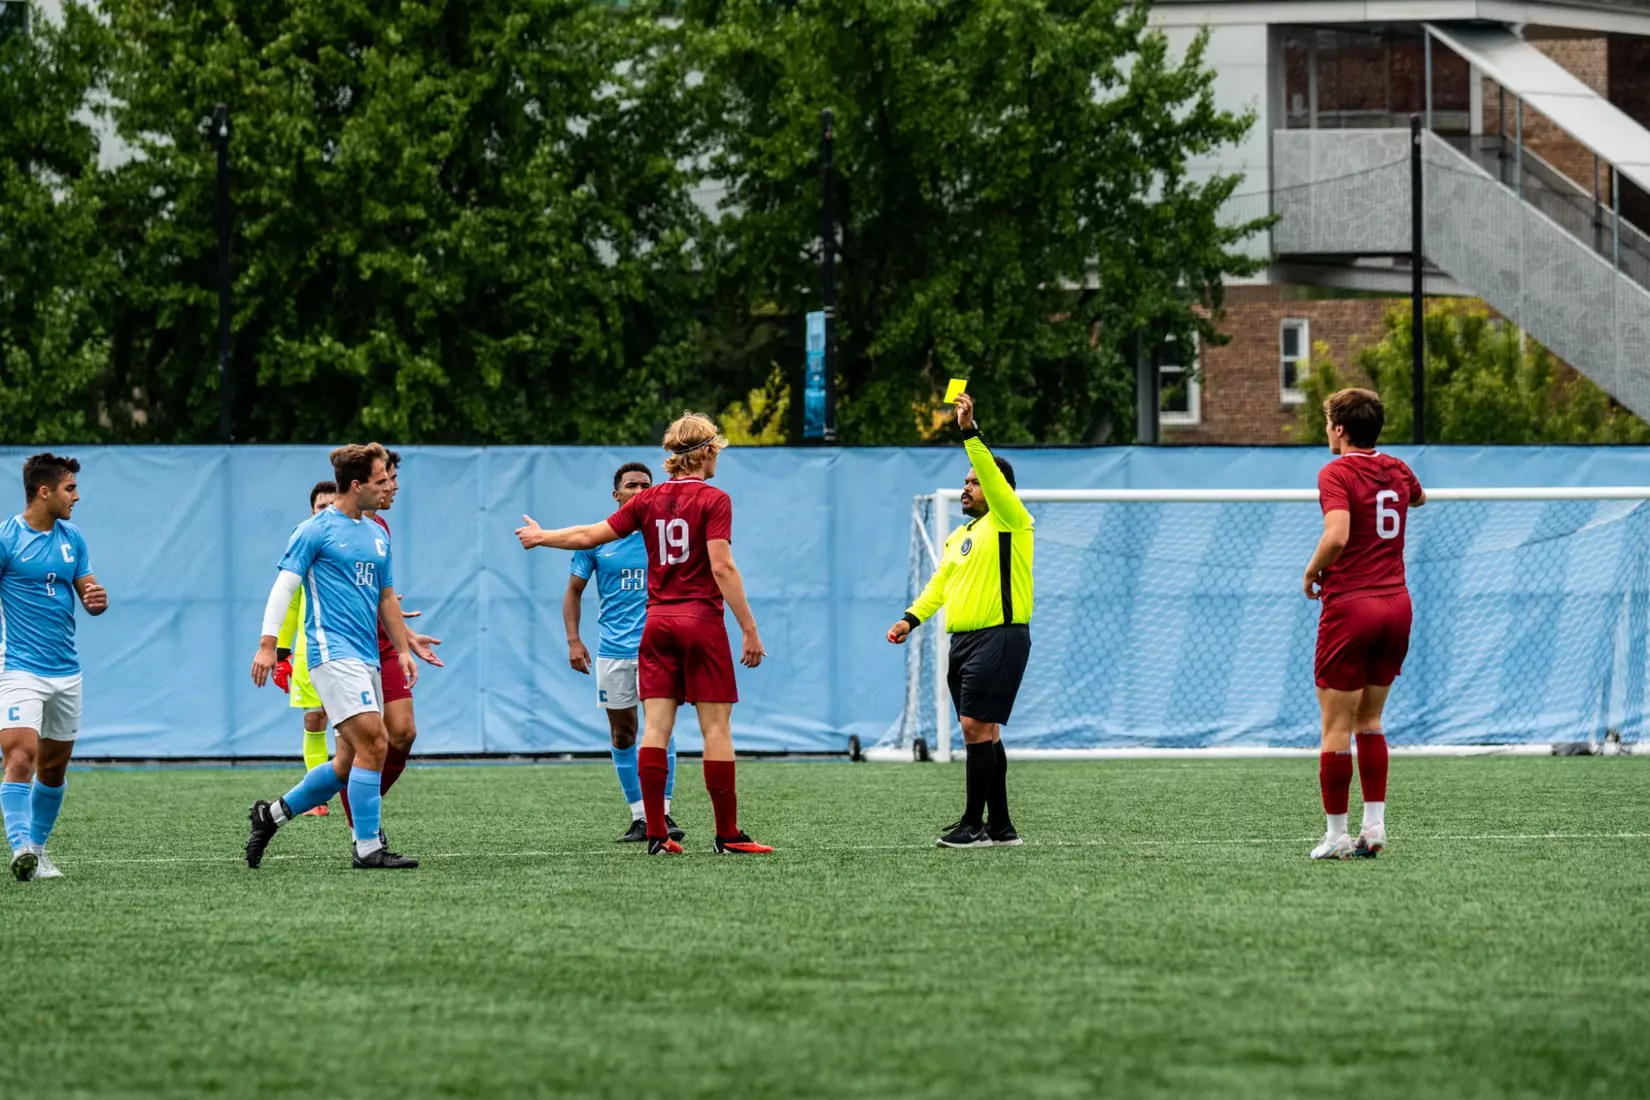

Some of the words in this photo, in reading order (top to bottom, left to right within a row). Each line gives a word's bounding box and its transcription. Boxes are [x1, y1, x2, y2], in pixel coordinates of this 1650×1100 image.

[1376, 489, 1400, 539] 6
[61, 543, 74, 563] C
[375, 538, 386, 557] C
[655, 518, 690, 566] 19
[46, 572, 57, 596] 2
[355, 561, 375, 587] 26
[621, 568, 645, 590] 29
[360, 690, 373, 705] C
[8, 706, 20, 721] C
